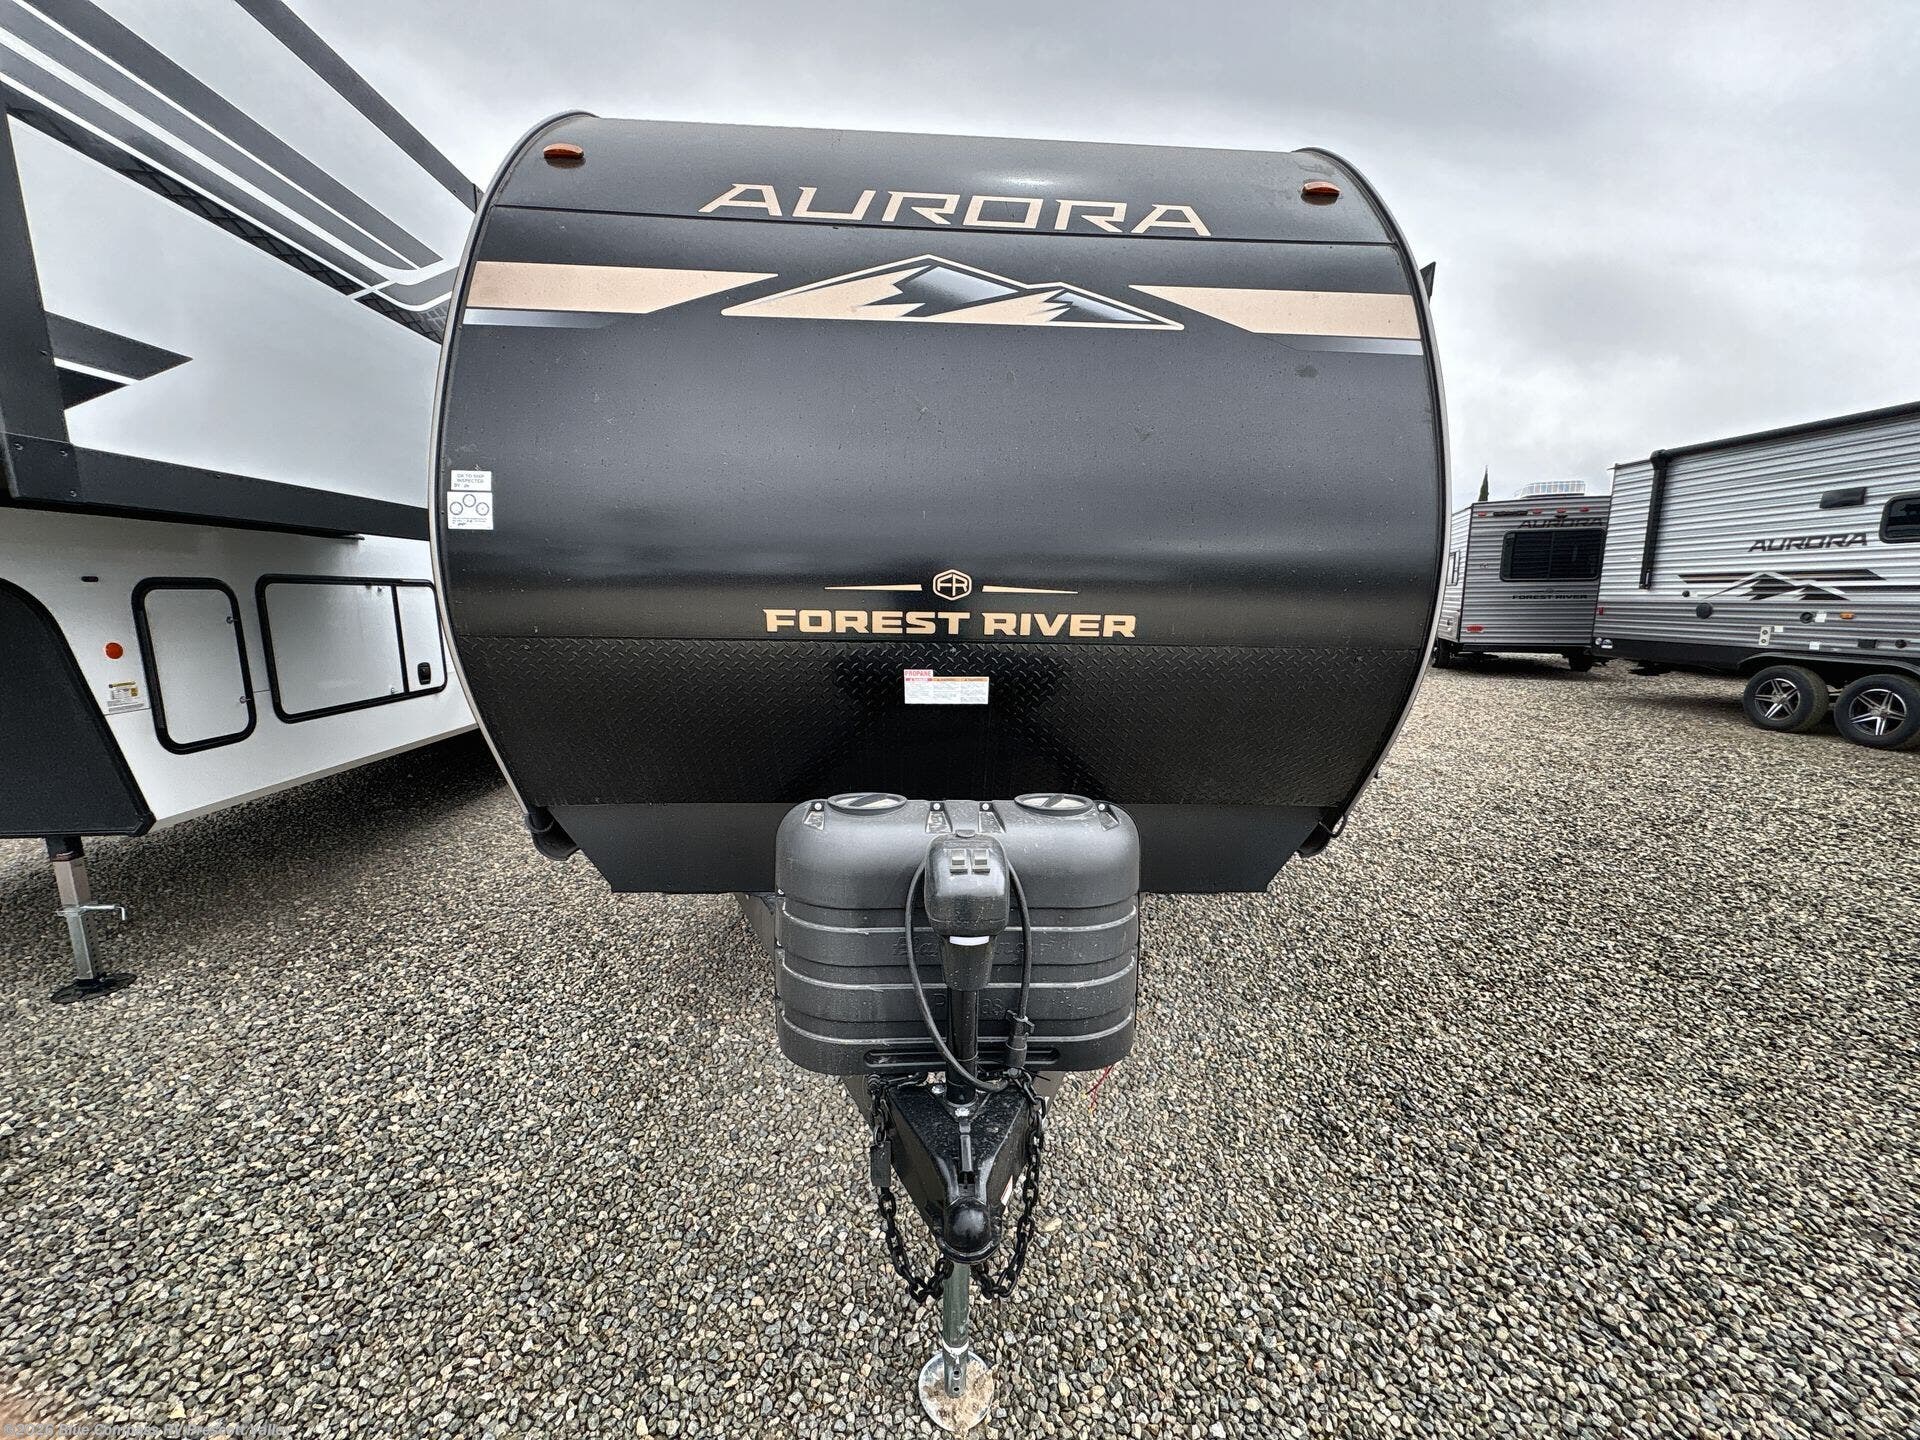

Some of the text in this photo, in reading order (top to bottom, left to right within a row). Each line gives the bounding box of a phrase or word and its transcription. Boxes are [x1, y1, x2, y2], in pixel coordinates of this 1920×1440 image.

[698, 183, 1212, 237] AURORA
[1747, 532, 1868, 553] AURORA
[762, 608, 1137, 638] FOREST RIVER
